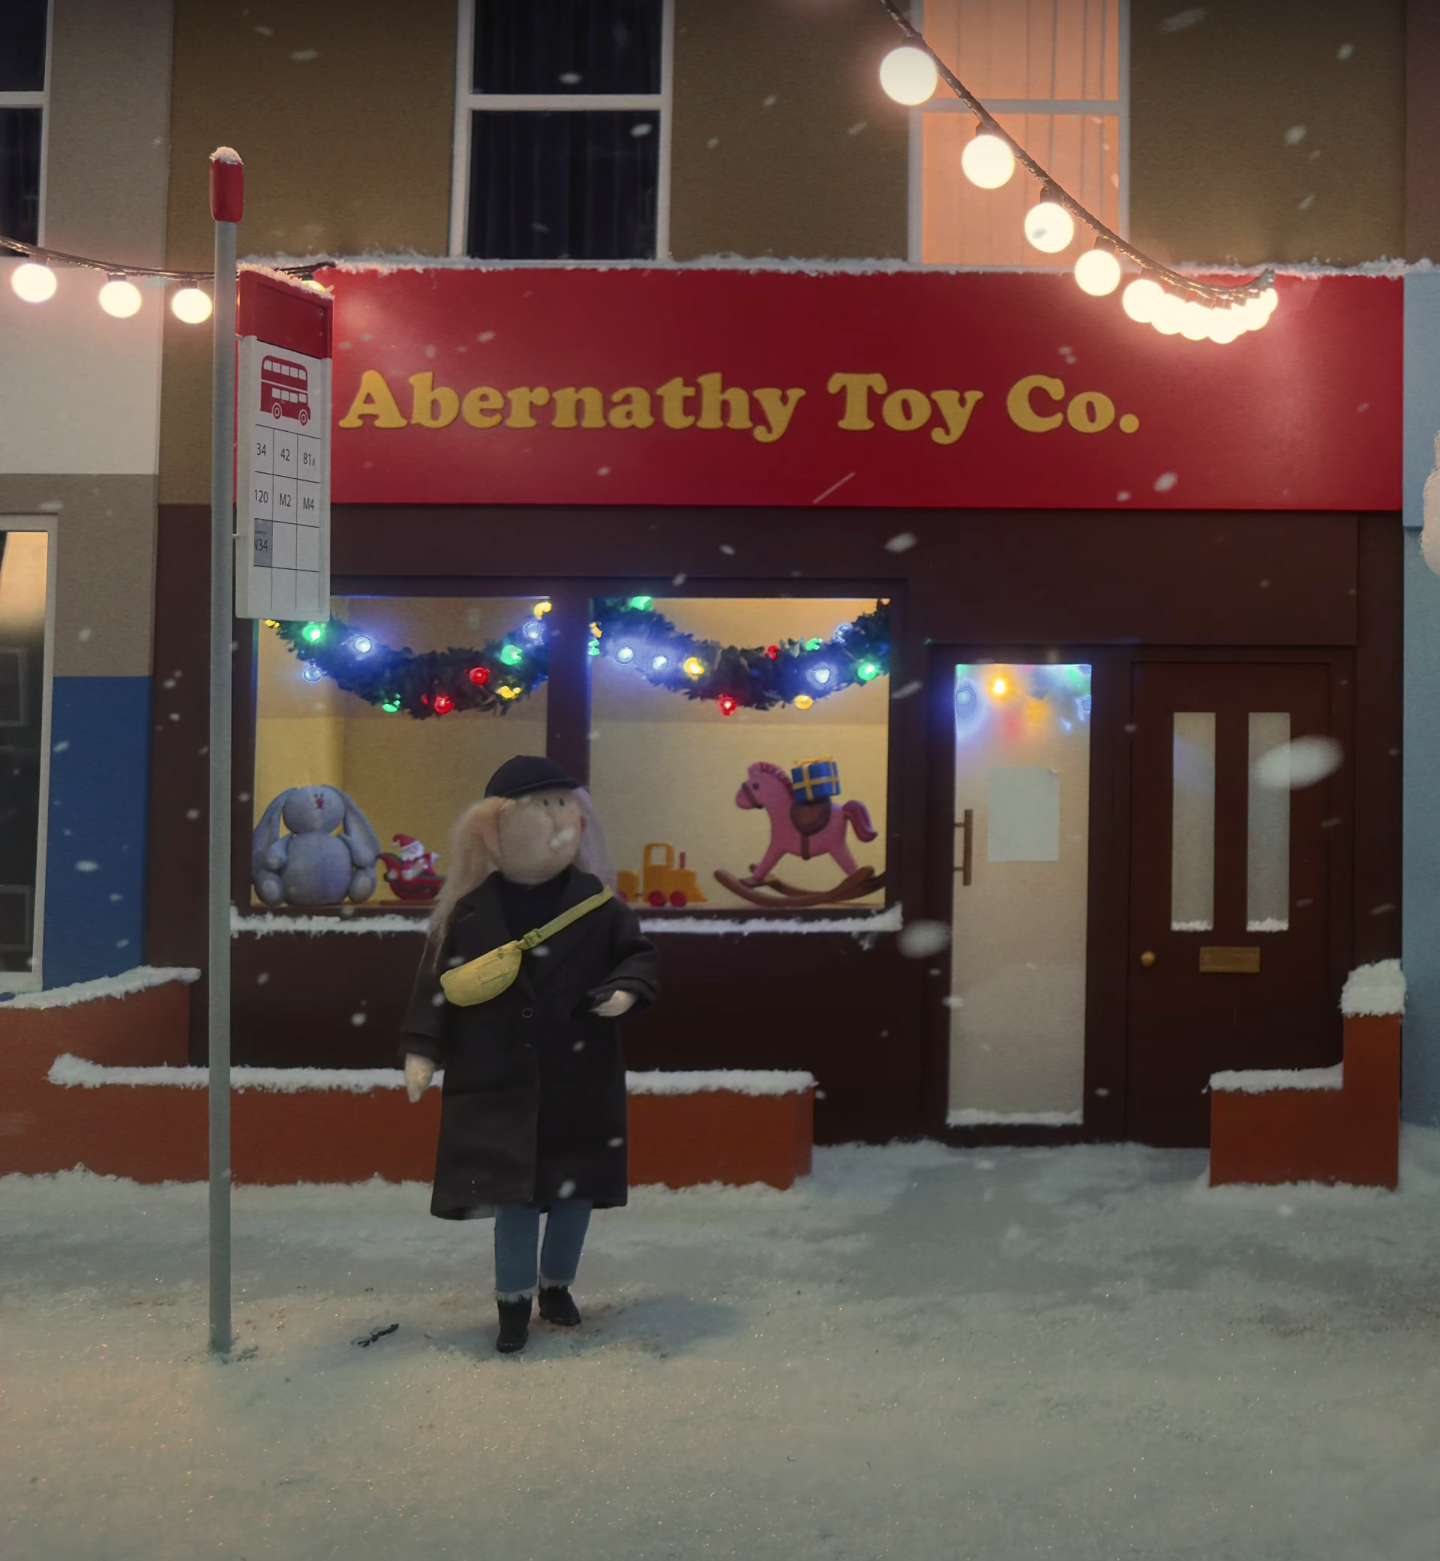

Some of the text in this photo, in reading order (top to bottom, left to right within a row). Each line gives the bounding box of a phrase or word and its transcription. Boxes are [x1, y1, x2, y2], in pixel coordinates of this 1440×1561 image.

[338, 369, 1140, 444] Abernathy Toy Co.
[256, 442, 267, 456] 34
[280, 447, 291, 462] 42
[254, 489, 315, 511] 120 M2 M4
